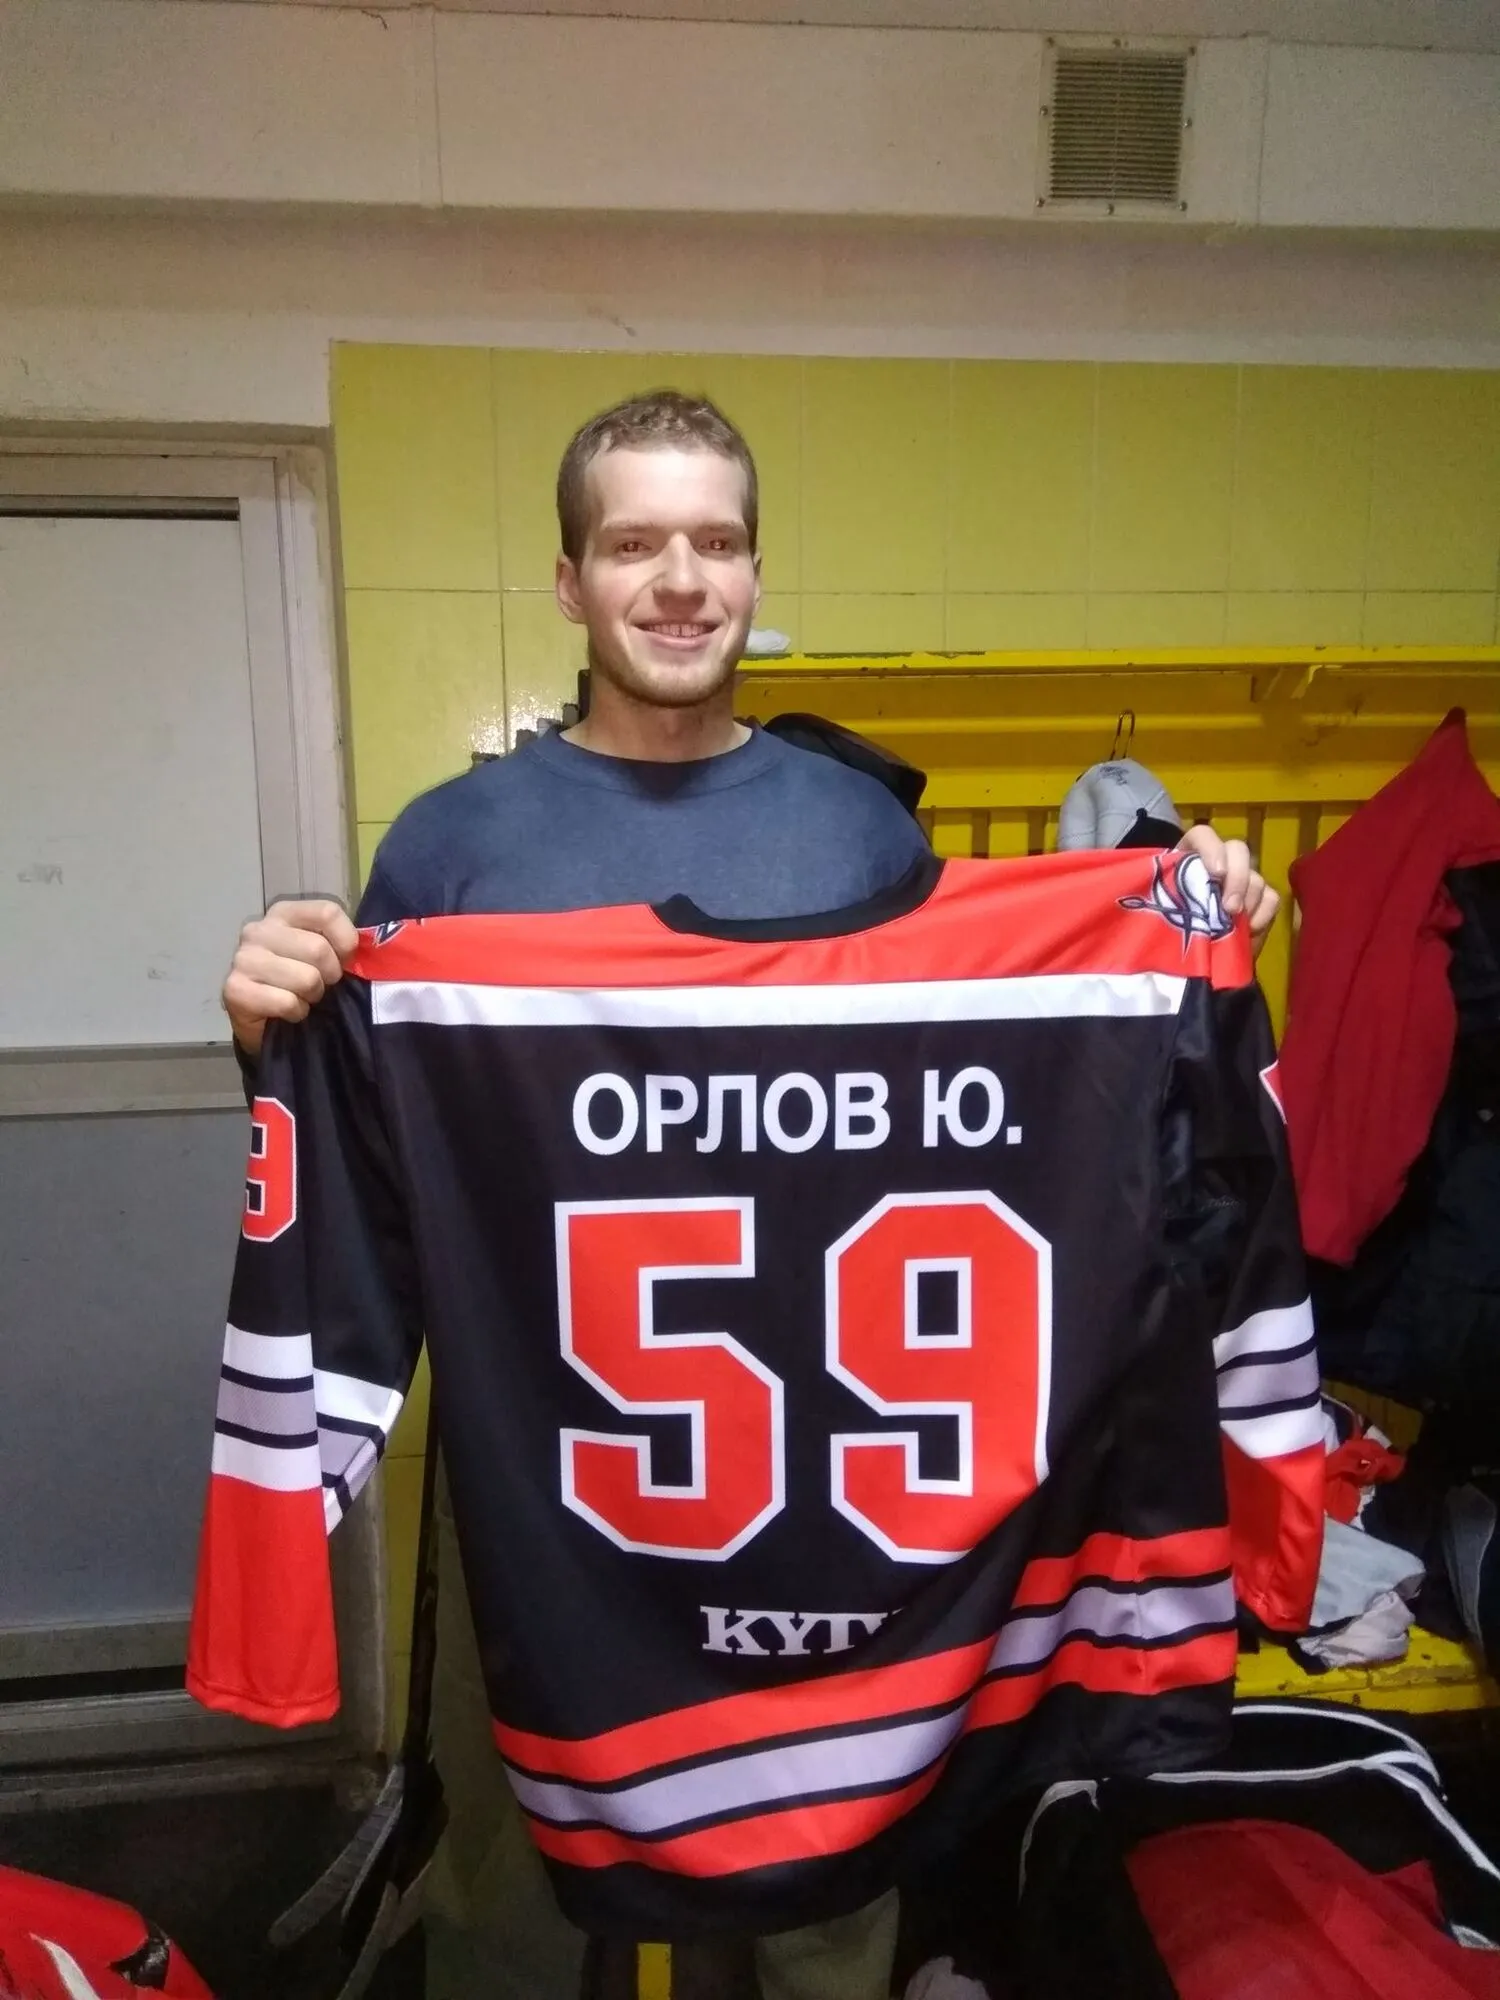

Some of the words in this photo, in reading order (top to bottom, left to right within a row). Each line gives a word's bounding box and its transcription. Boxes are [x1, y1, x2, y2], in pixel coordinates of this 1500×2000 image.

[573, 1071, 891, 1155] ОРЛОВ
[922, 1066, 1022, 1147] Ю.
[554, 1190, 1053, 1564] 59
